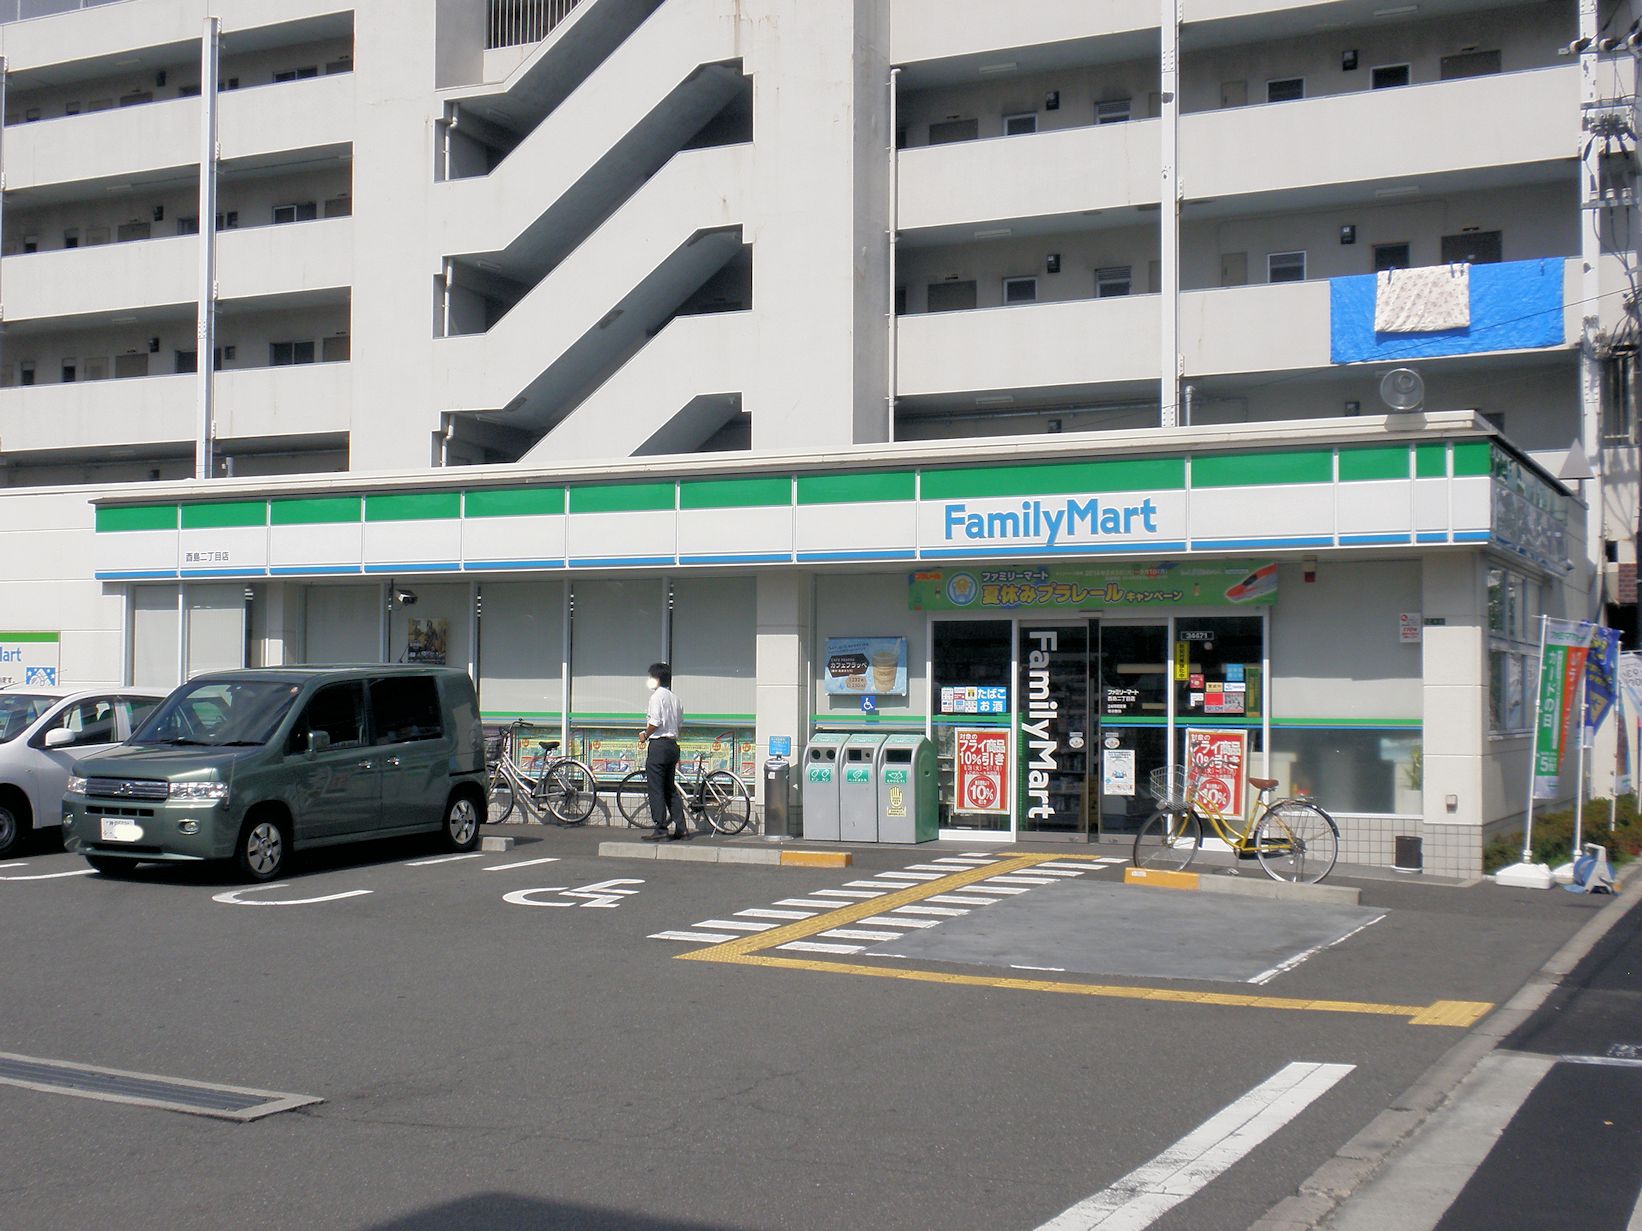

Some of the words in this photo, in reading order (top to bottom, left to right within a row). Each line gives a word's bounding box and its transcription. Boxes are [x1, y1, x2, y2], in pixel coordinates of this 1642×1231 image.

[945, 498, 1157, 547] FamilyMart
[982, 571, 1048, 582] ファミリーマート
[981, 581, 1124, 606] 夏休みプラレール
[1126, 590, 1183, 603] キャンペーン
[0, 646, 22, 663] art
[830, 661, 867, 669] カフェフラッペ
[978, 688, 1006, 700] たばこ
[1021, 631, 1058, 819] FamilyMart
[960, 739, 1006, 754] フライ商品
[960, 751, 1005, 766] 10%引き
[970, 784, 993, 800] 10%
